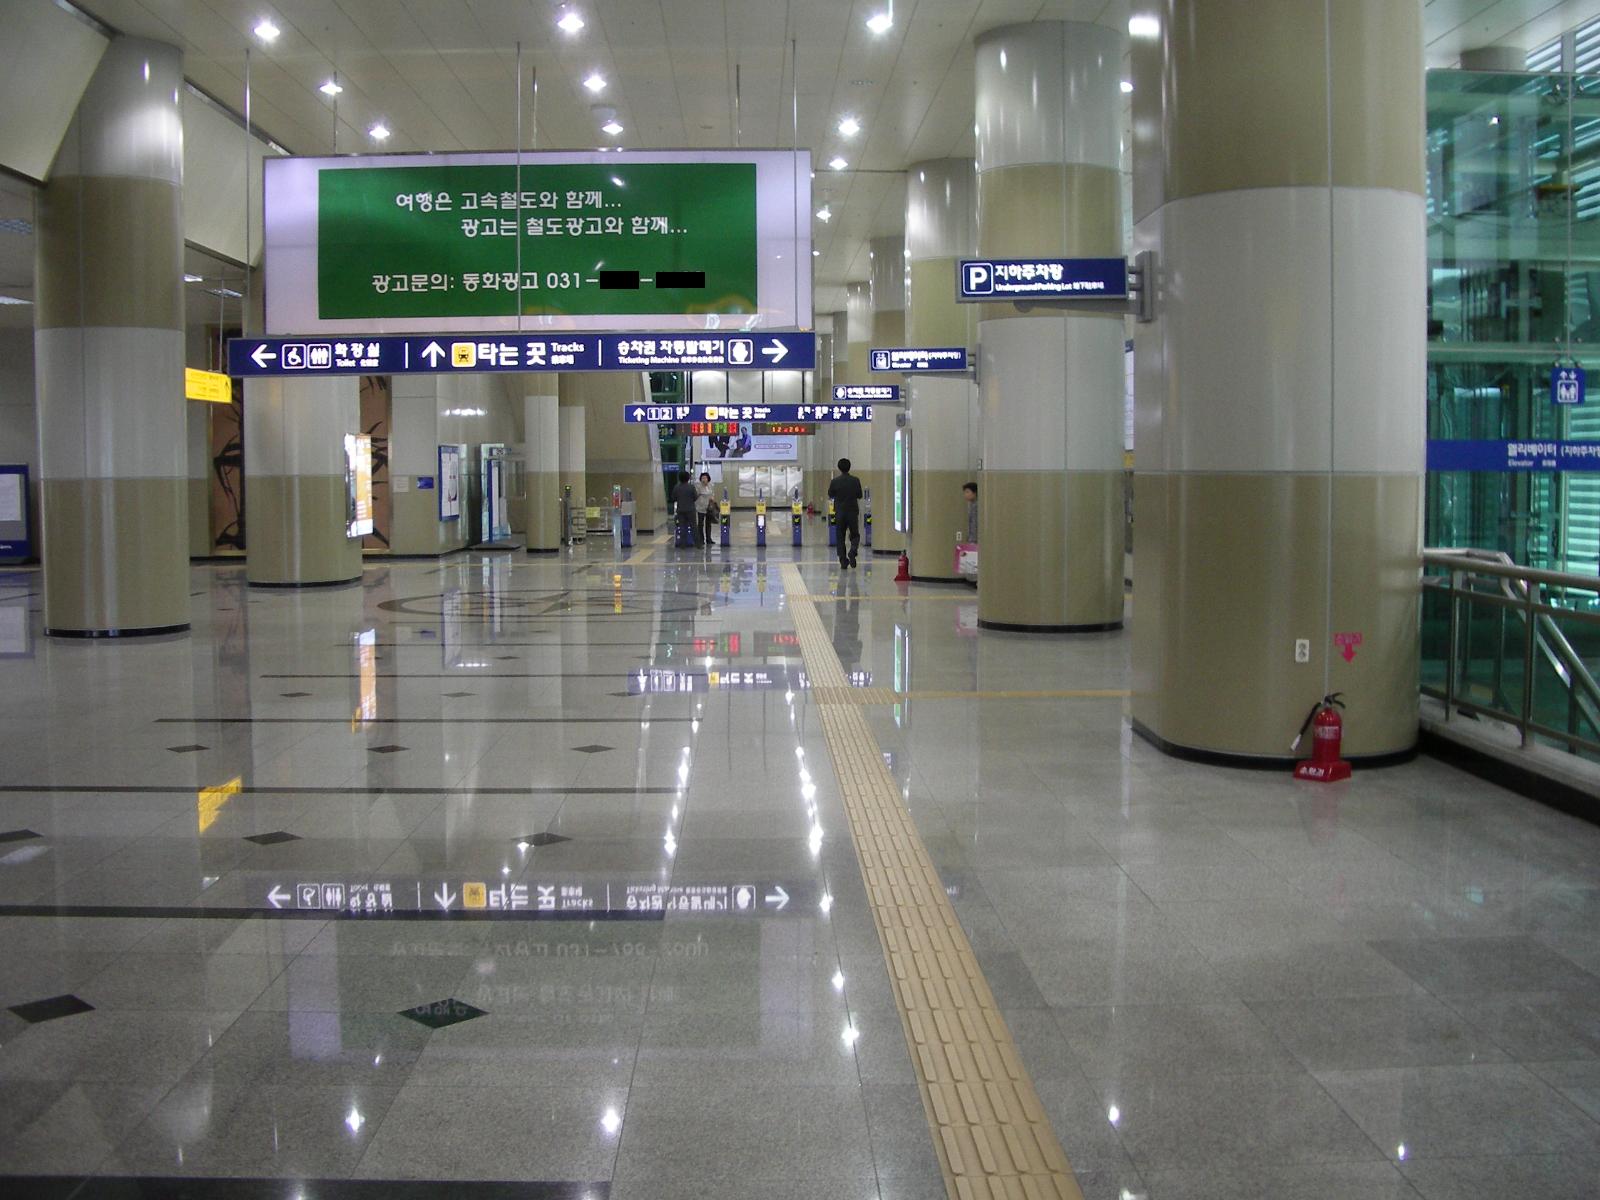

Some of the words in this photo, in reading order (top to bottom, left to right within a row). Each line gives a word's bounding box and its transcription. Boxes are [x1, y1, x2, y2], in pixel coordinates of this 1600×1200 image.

[395, 191, 453, 212] 여행은
[461, 191, 558, 210] 고속철도와
[460, 218, 518, 238] 광고는
[526, 216, 624, 236] 철도광고와
[371, 273, 455, 293] 광고문의:
[462, 272, 540, 291] 동화광고
[969, 266, 988, 291] P
[995, 264, 1064, 281] 지하주차장
[478, 342, 519, 366] 타는
[526, 342, 546, 366] 곳
[550, 342, 585, 353] Tracks
